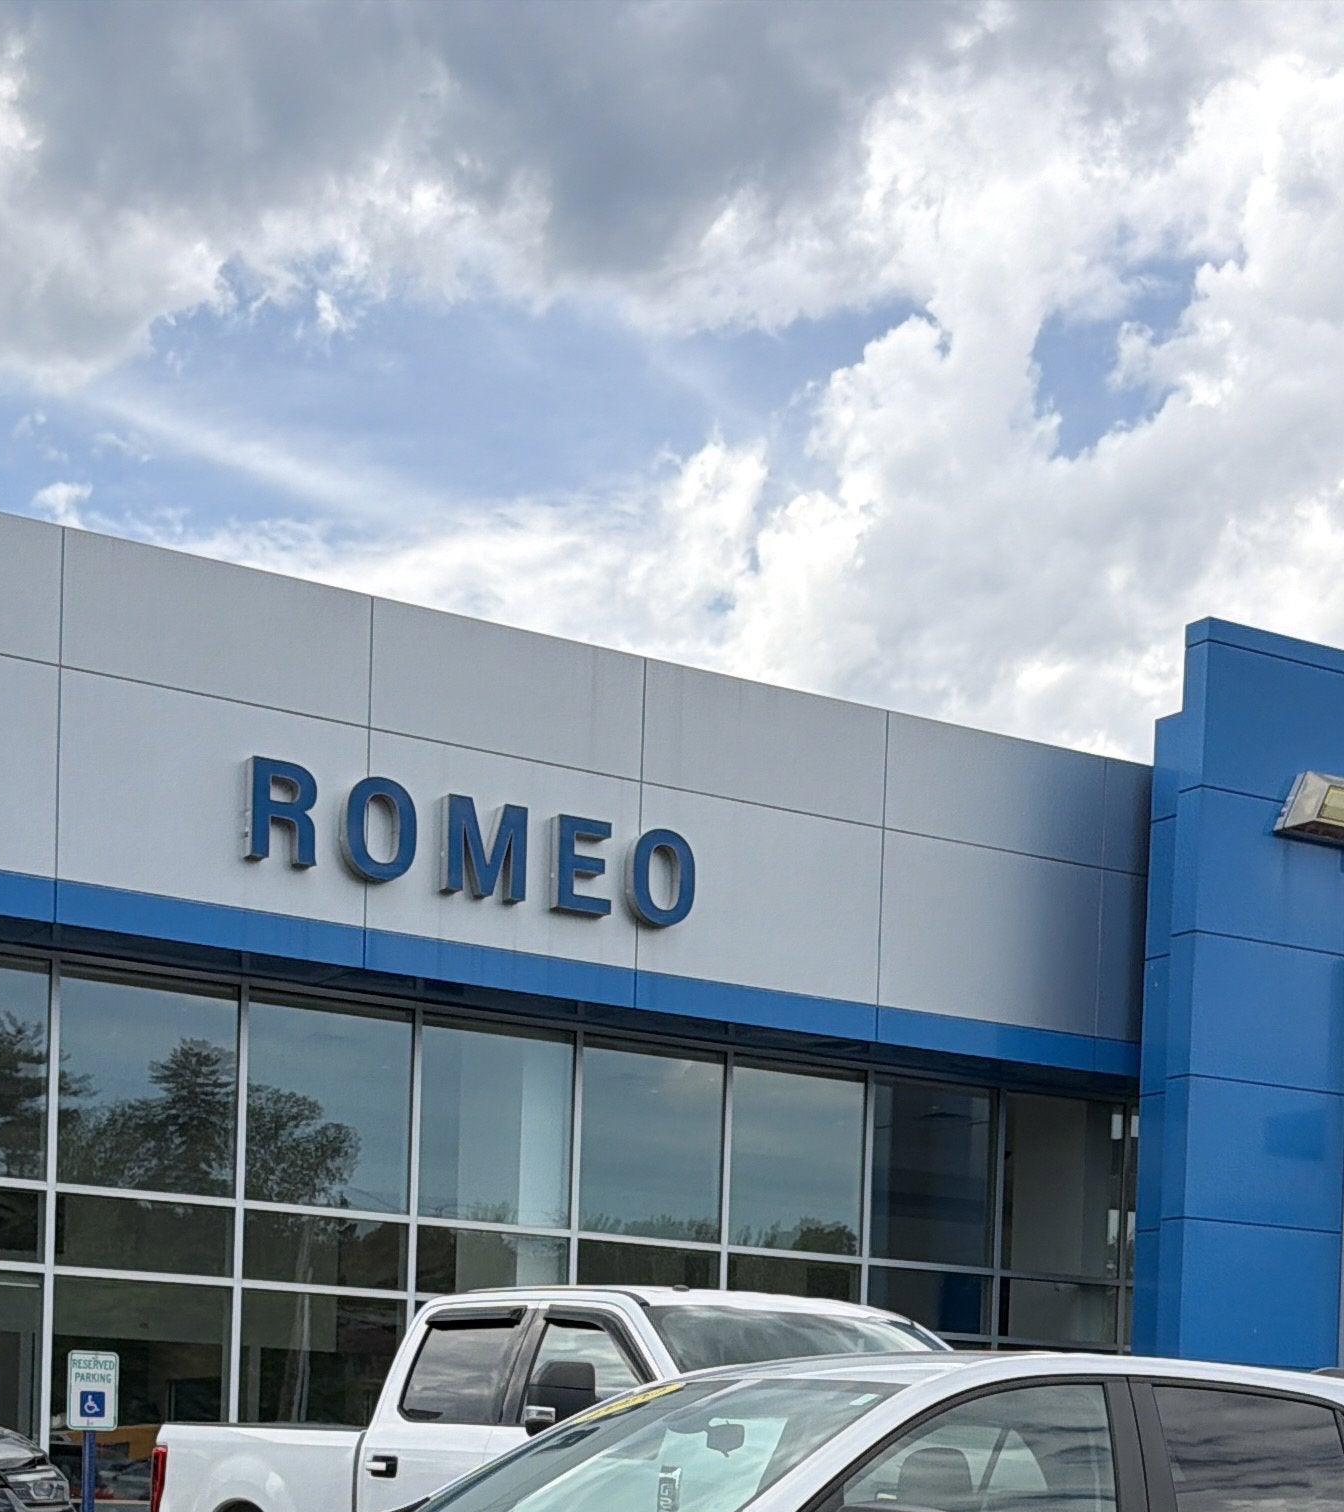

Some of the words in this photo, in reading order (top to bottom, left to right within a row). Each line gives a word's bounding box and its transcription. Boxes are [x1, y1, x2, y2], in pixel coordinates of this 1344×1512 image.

[245, 756, 695, 928] ROMEO
[71, 1359, 115, 1371] RESERVED
[74, 1373, 112, 1384] PARKING
